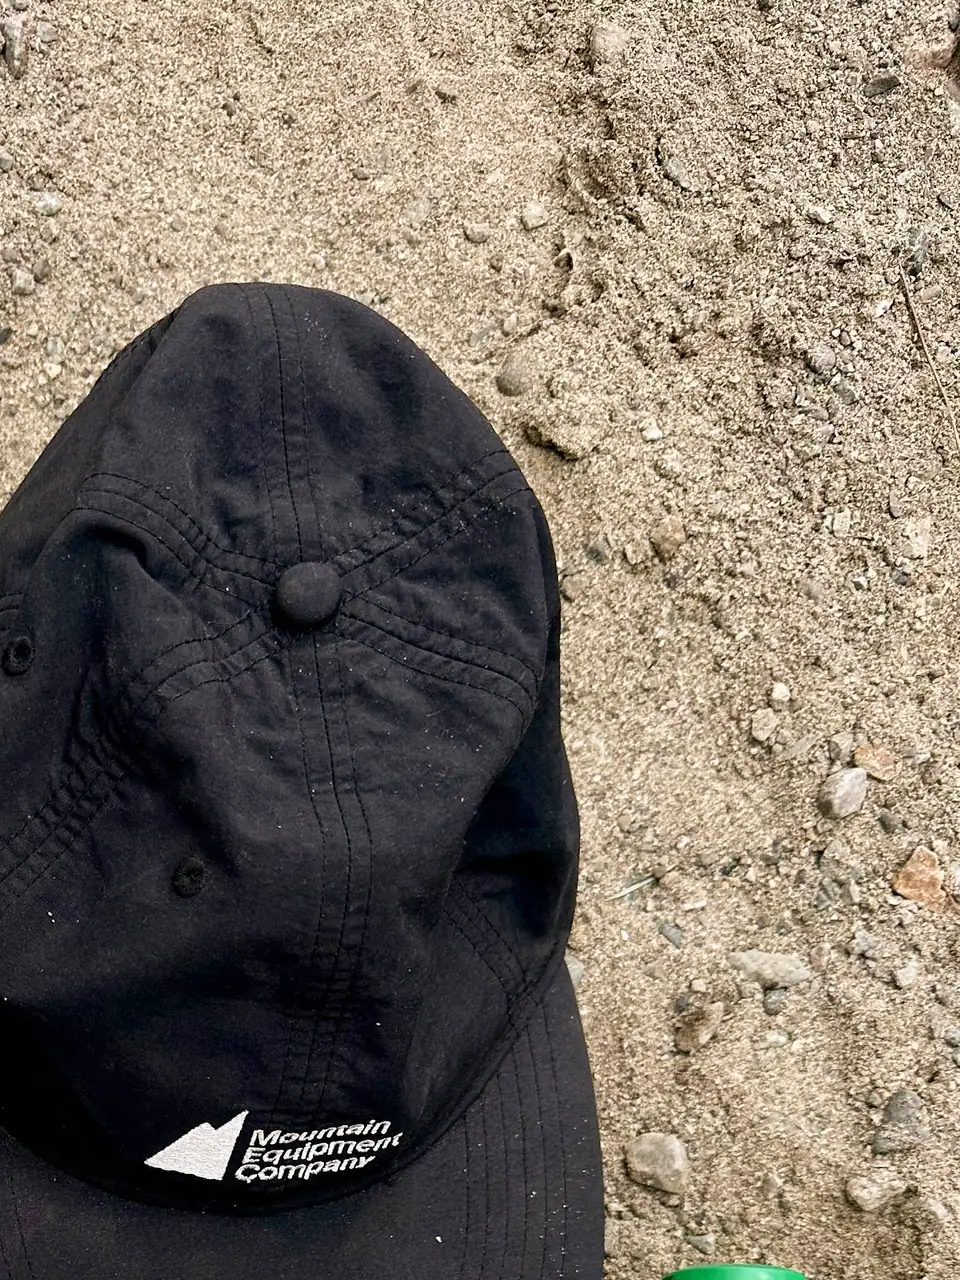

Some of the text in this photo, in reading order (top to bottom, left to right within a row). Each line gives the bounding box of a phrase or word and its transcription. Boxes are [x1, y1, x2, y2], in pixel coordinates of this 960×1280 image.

[249, 1119, 392, 1148] Mountain
[241, 1132, 404, 1165] Equipment
[235, 1155, 376, 1184] Company
